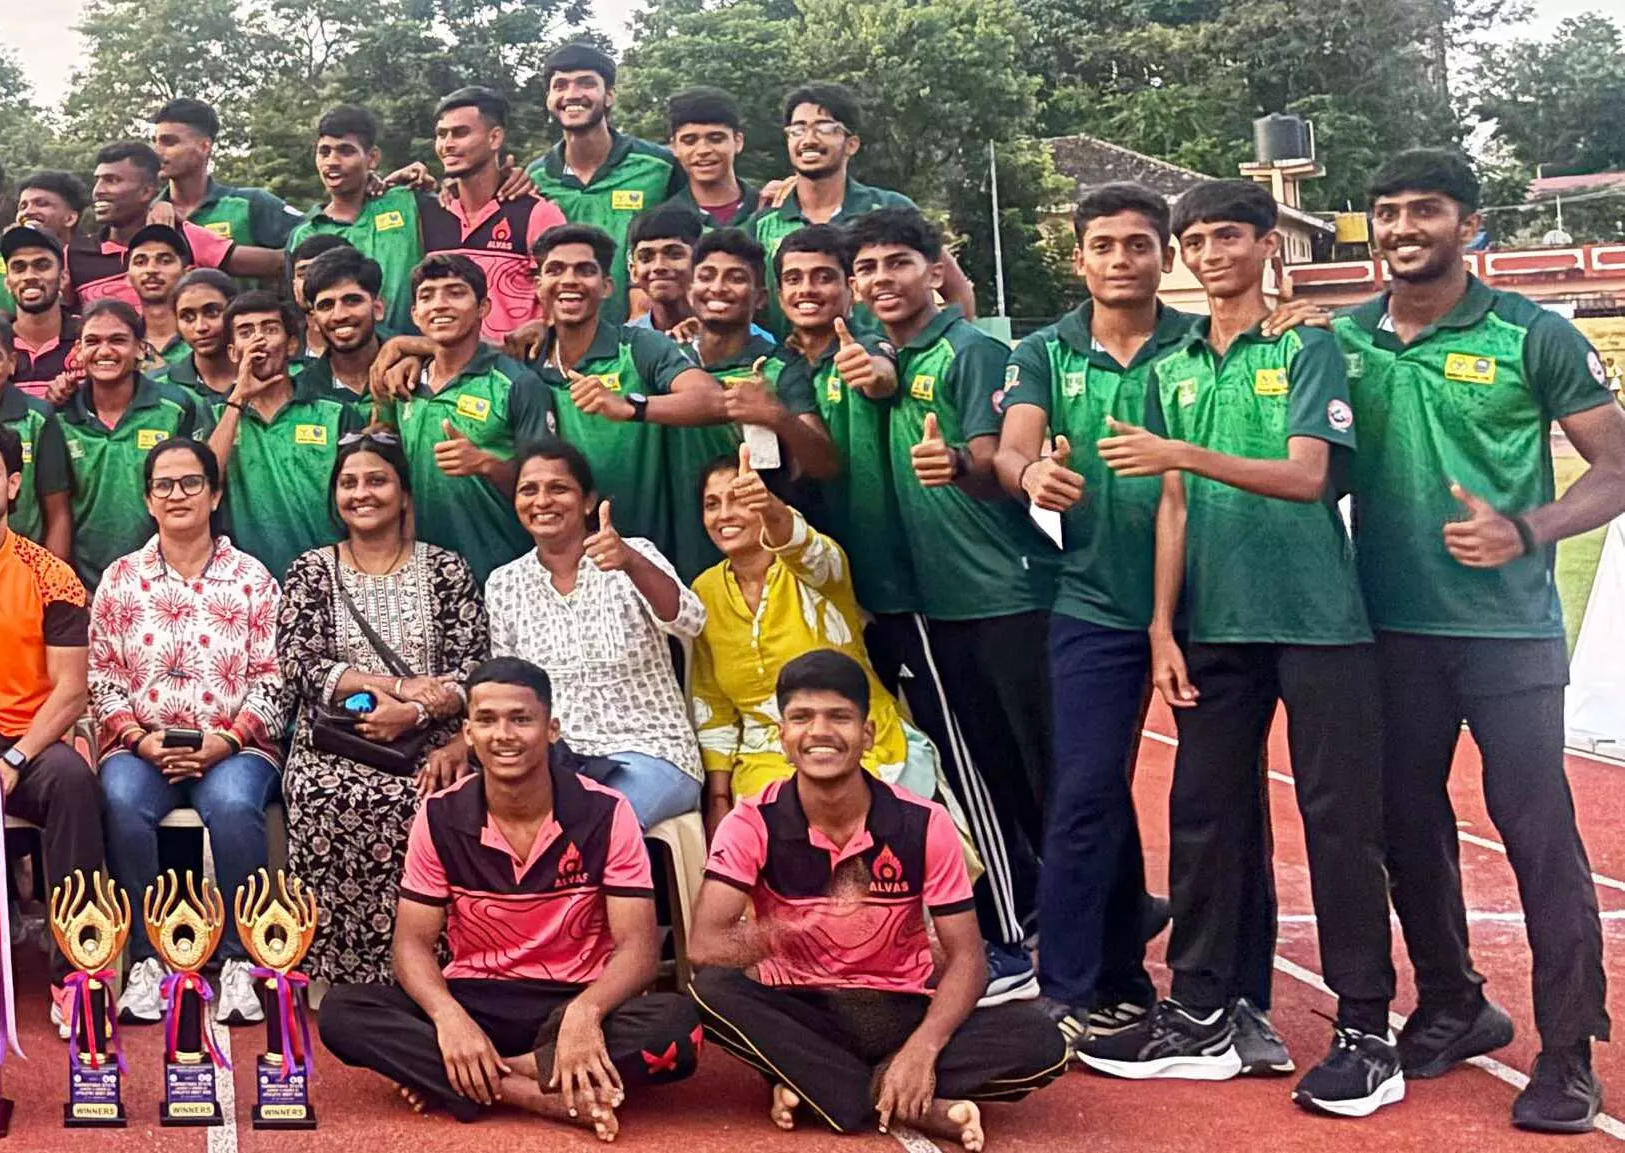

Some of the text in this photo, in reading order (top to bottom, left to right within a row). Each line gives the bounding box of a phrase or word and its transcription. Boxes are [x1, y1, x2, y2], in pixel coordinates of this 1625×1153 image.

[487, 240, 513, 250] ALVAS
[869, 881, 909, 893] ALVAS
[76, 1106, 115, 1116] WINNERS
[173, 1105, 212, 1115] WINNERS
[265, 1107, 304, 1117] WINNERS
